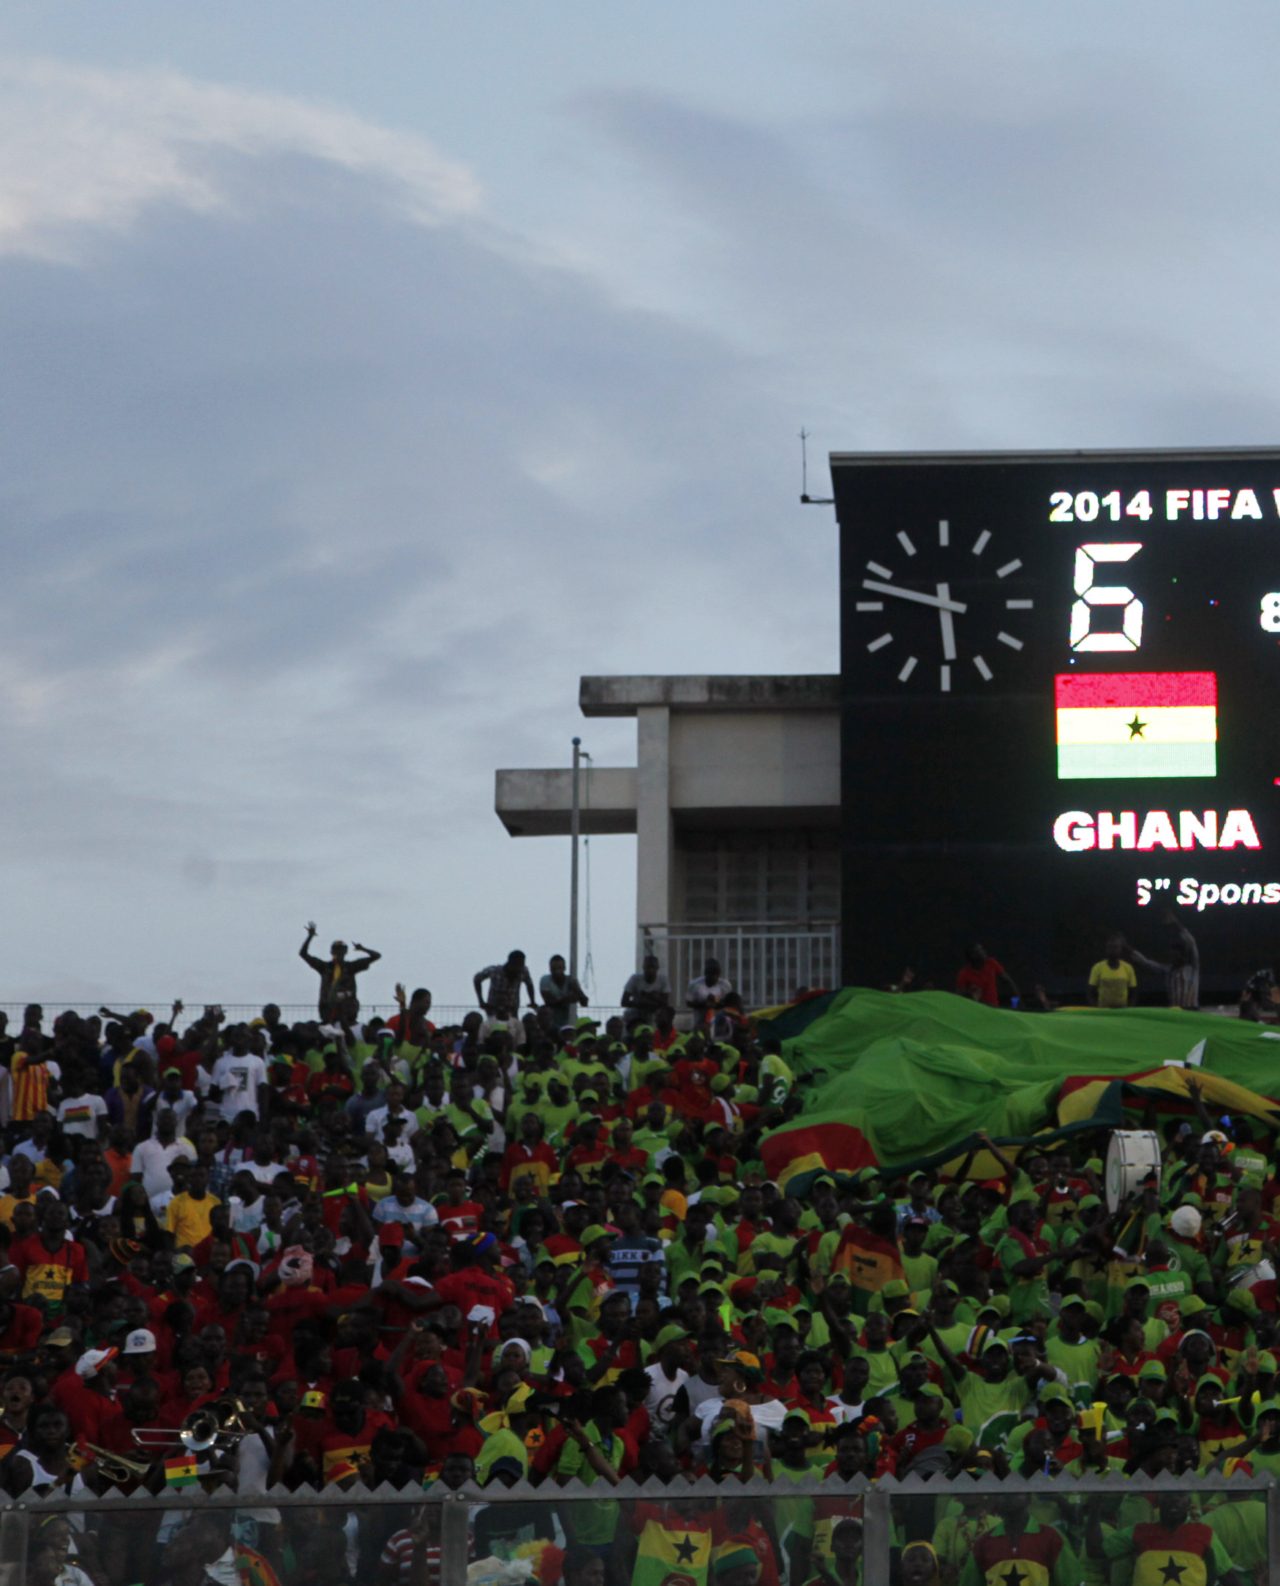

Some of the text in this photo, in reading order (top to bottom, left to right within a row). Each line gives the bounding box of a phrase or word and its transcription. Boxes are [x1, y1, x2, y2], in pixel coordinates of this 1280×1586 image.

[1049, 490, 1154, 522] 2014
[1166, 488, 1263, 520] FIFA
[1070, 541, 1144, 652] 6
[1053, 809, 1262, 851] GHANA
